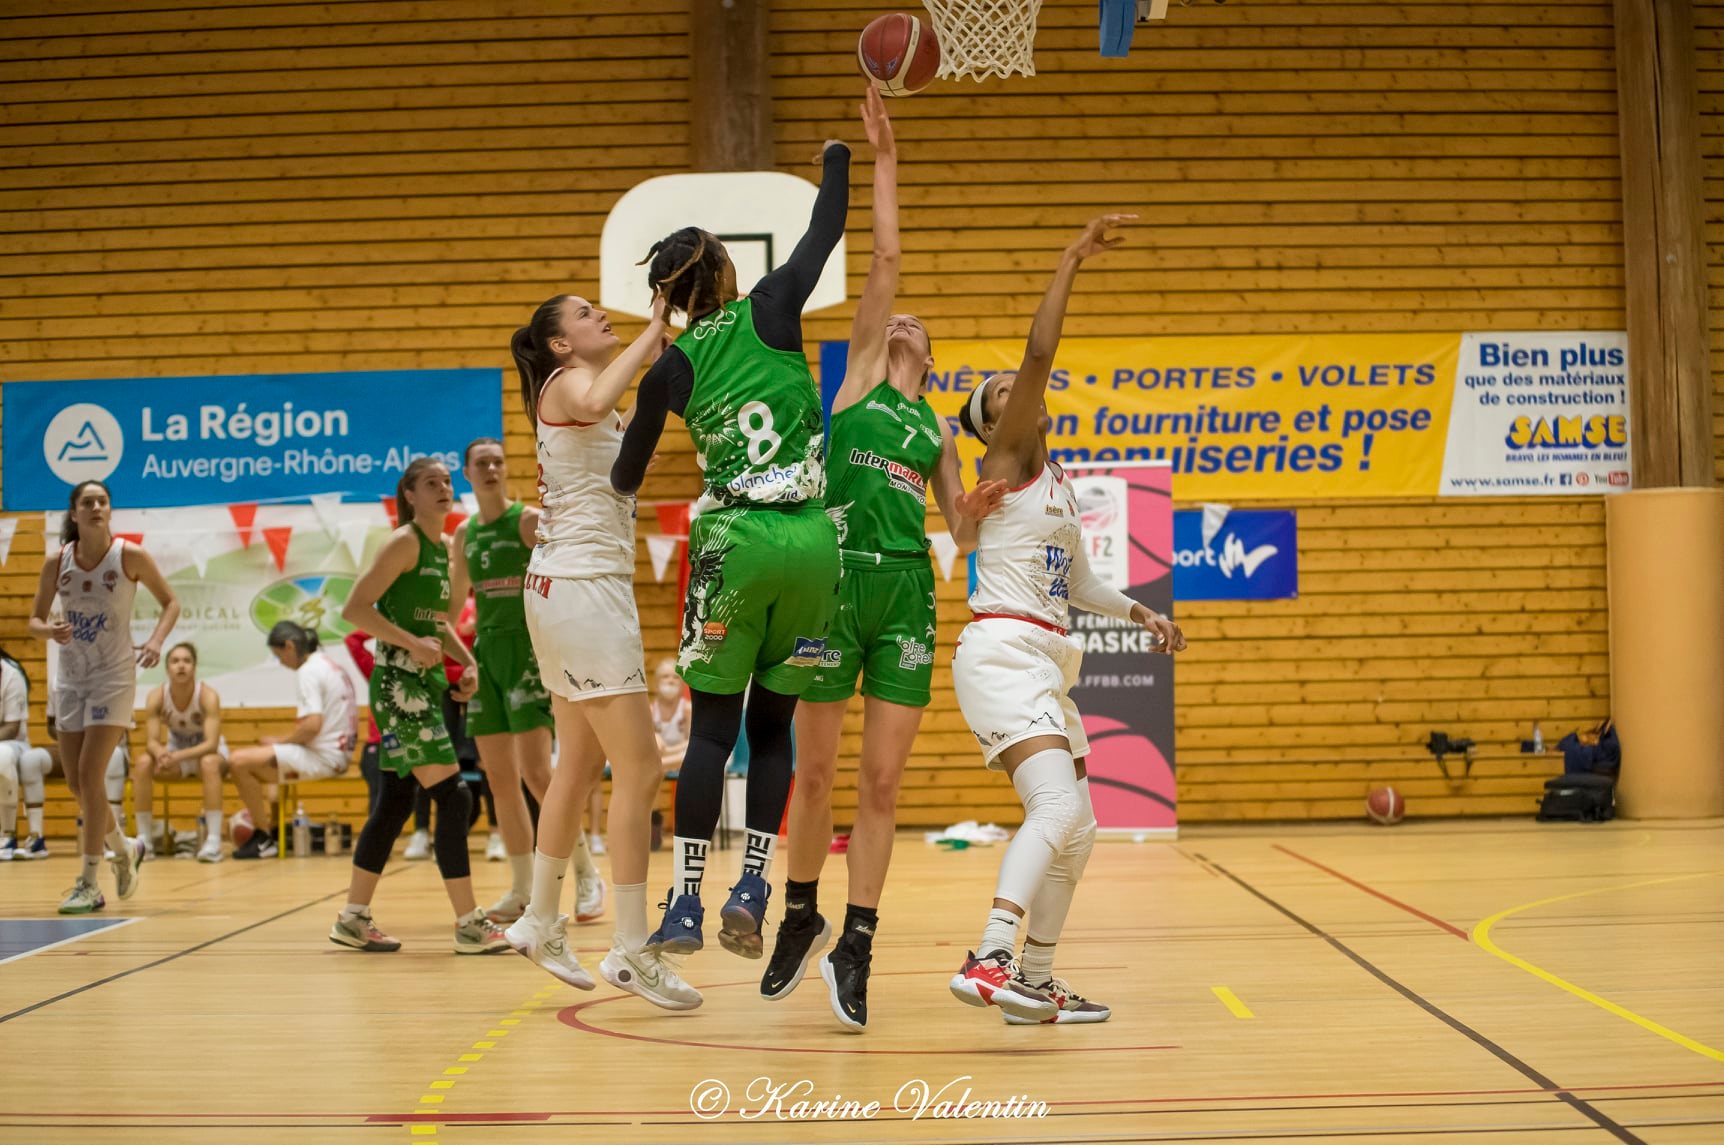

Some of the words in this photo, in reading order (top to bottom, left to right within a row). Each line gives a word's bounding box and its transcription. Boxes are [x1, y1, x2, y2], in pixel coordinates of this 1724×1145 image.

[1479, 342, 1549, 367] Bien
[1560, 341, 1625, 372] plus
[1111, 366, 1257, 391] PORTES
[1298, 363, 1437, 388] VOLETS
[1464, 373, 1497, 390] que
[1503, 371, 1534, 387] des
[1539, 370, 1625, 387] matériaux
[1479, 391, 1500, 406] de
[1506, 389, 1615, 406] construction
[141, 406, 190, 442] La
[200, 401, 349, 447] Région
[737, 400, 782, 465] 8
[1093, 404, 1281, 436] fourniture
[1294, 404, 1332, 433] et
[1341, 407, 1432, 439] pose
[1504, 414, 1628, 451] SAMSE
[901, 424, 918, 449] 7
[1449, 473, 1555, 488] www.samse.fr
[480, 551, 490, 569] 5
